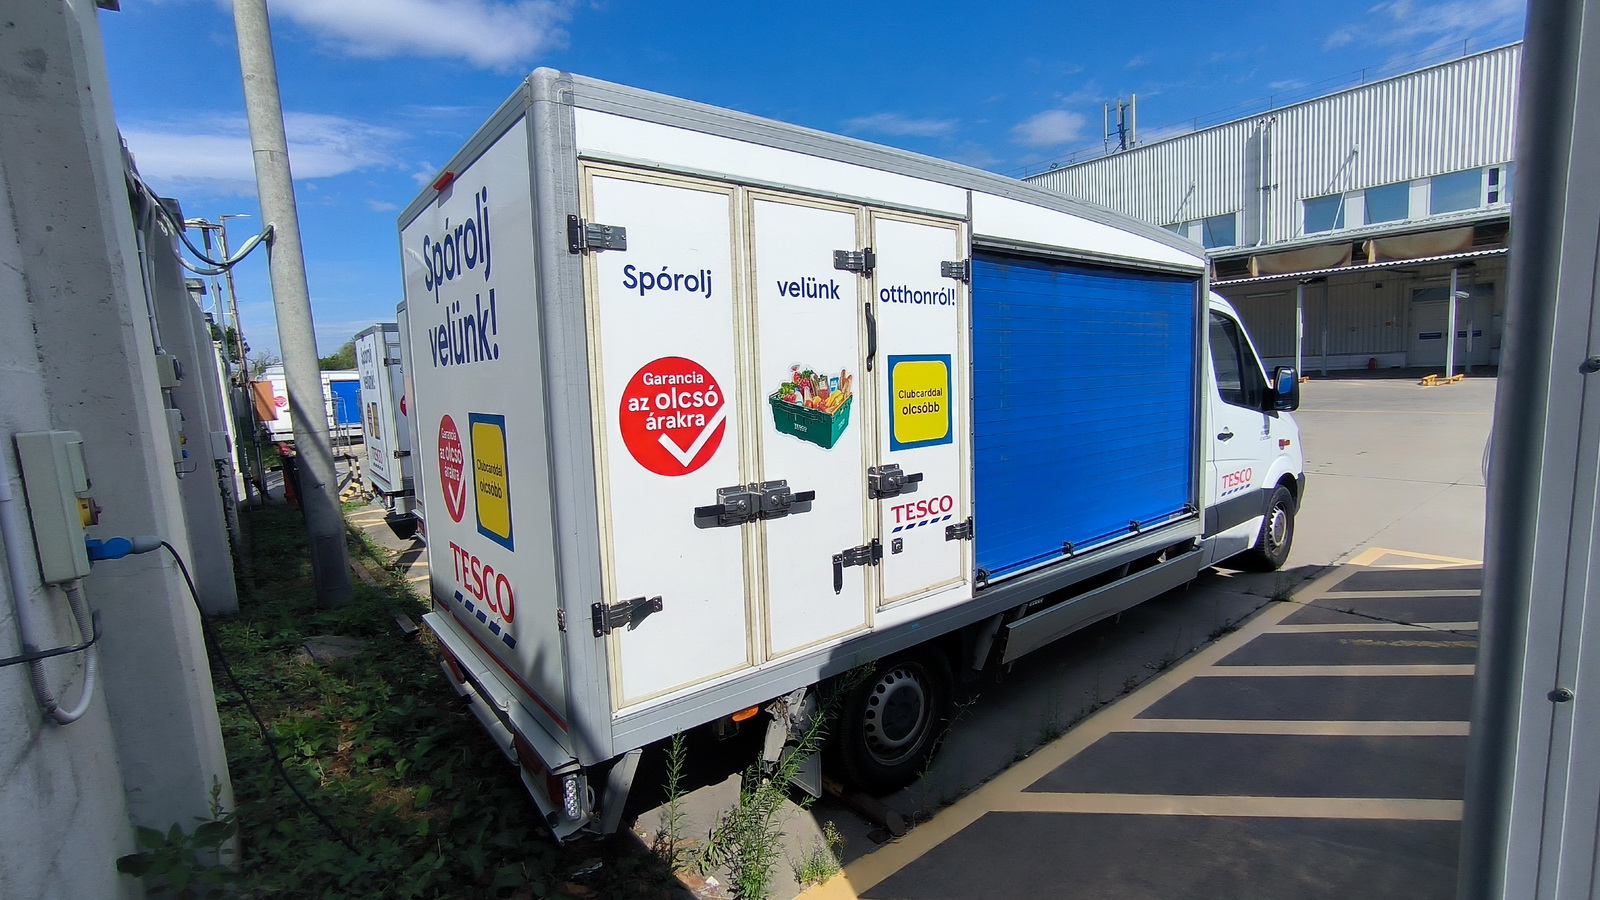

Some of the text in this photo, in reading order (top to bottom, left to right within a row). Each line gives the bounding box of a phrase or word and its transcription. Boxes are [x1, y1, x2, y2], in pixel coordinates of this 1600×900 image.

[423, 186, 492, 304] Spórolj
[623, 264, 956, 306] Spórolj velünk otthonról!
[428, 288, 499, 368] velünk!
[643, 371, 704, 386] Garancia
[628, 385, 719, 412] az olcsó
[898, 388, 943, 399] Clubcarddal
[902, 401, 940, 415] olcsóbb
[645, 411, 705, 431] árakra
[441, 427, 457, 441] Garancia
[446, 442, 462, 465] olcsó
[444, 462, 460, 482] árakra
[476, 459, 503, 477] Clubcarddal
[1222, 467, 1252, 489] TESCO
[480, 478, 503, 499] olcsóbb
[890, 495, 953, 523] TESCO
[449, 541, 515, 624] TESCO
